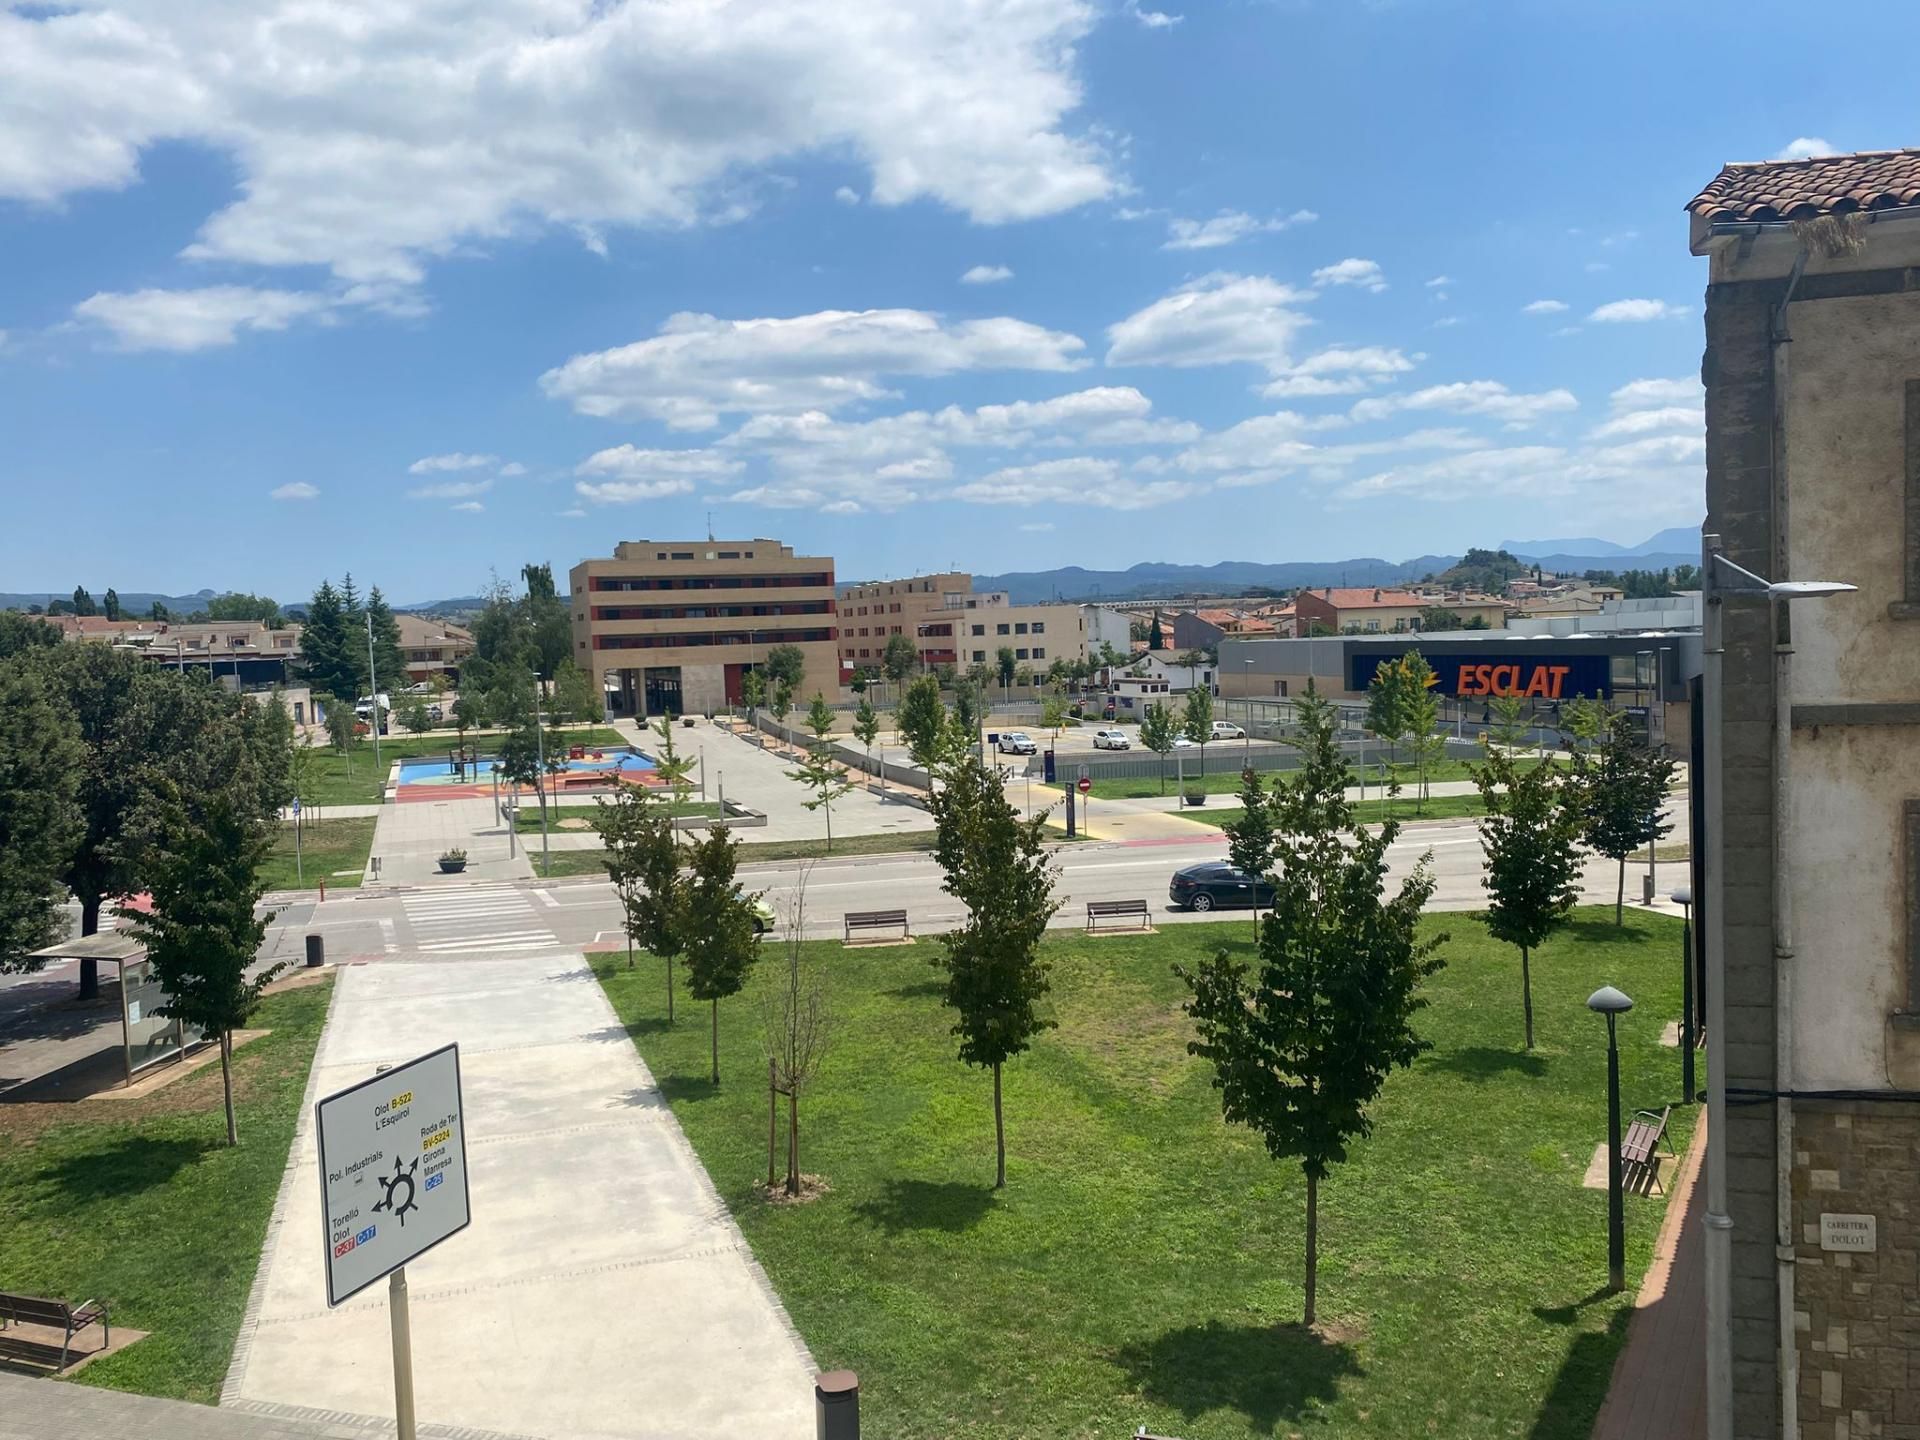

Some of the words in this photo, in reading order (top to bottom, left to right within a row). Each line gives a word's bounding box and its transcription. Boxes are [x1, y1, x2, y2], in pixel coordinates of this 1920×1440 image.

[1457, 664, 1571, 698] ESCLAT
[375, 1103, 389, 1117] Olot
[391, 1092, 412, 1109] B-522
[375, 1106, 410, 1131] L'Esquirol
[420, 1122, 438, 1137] Roda
[439, 1118, 447, 1129] de
[448, 1113, 458, 1124] Ter
[423, 1129, 450, 1150] BV-5224
[422, 1146, 446, 1164] Girona
[329, 1170, 343, 1184] Pol.
[345, 1151, 383, 1176] Industrials
[423, 1157, 452, 1177] Manresa
[426, 1173, 443, 1190] C-25
[332, 1206, 359, 1228] Torelló
[1826, 1221, 1869, 1230] CARRETERA
[333, 1227, 351, 1243] Olot
[335, 1238, 355, 1257] C-37
[357, 1226, 376, 1245] C-17
